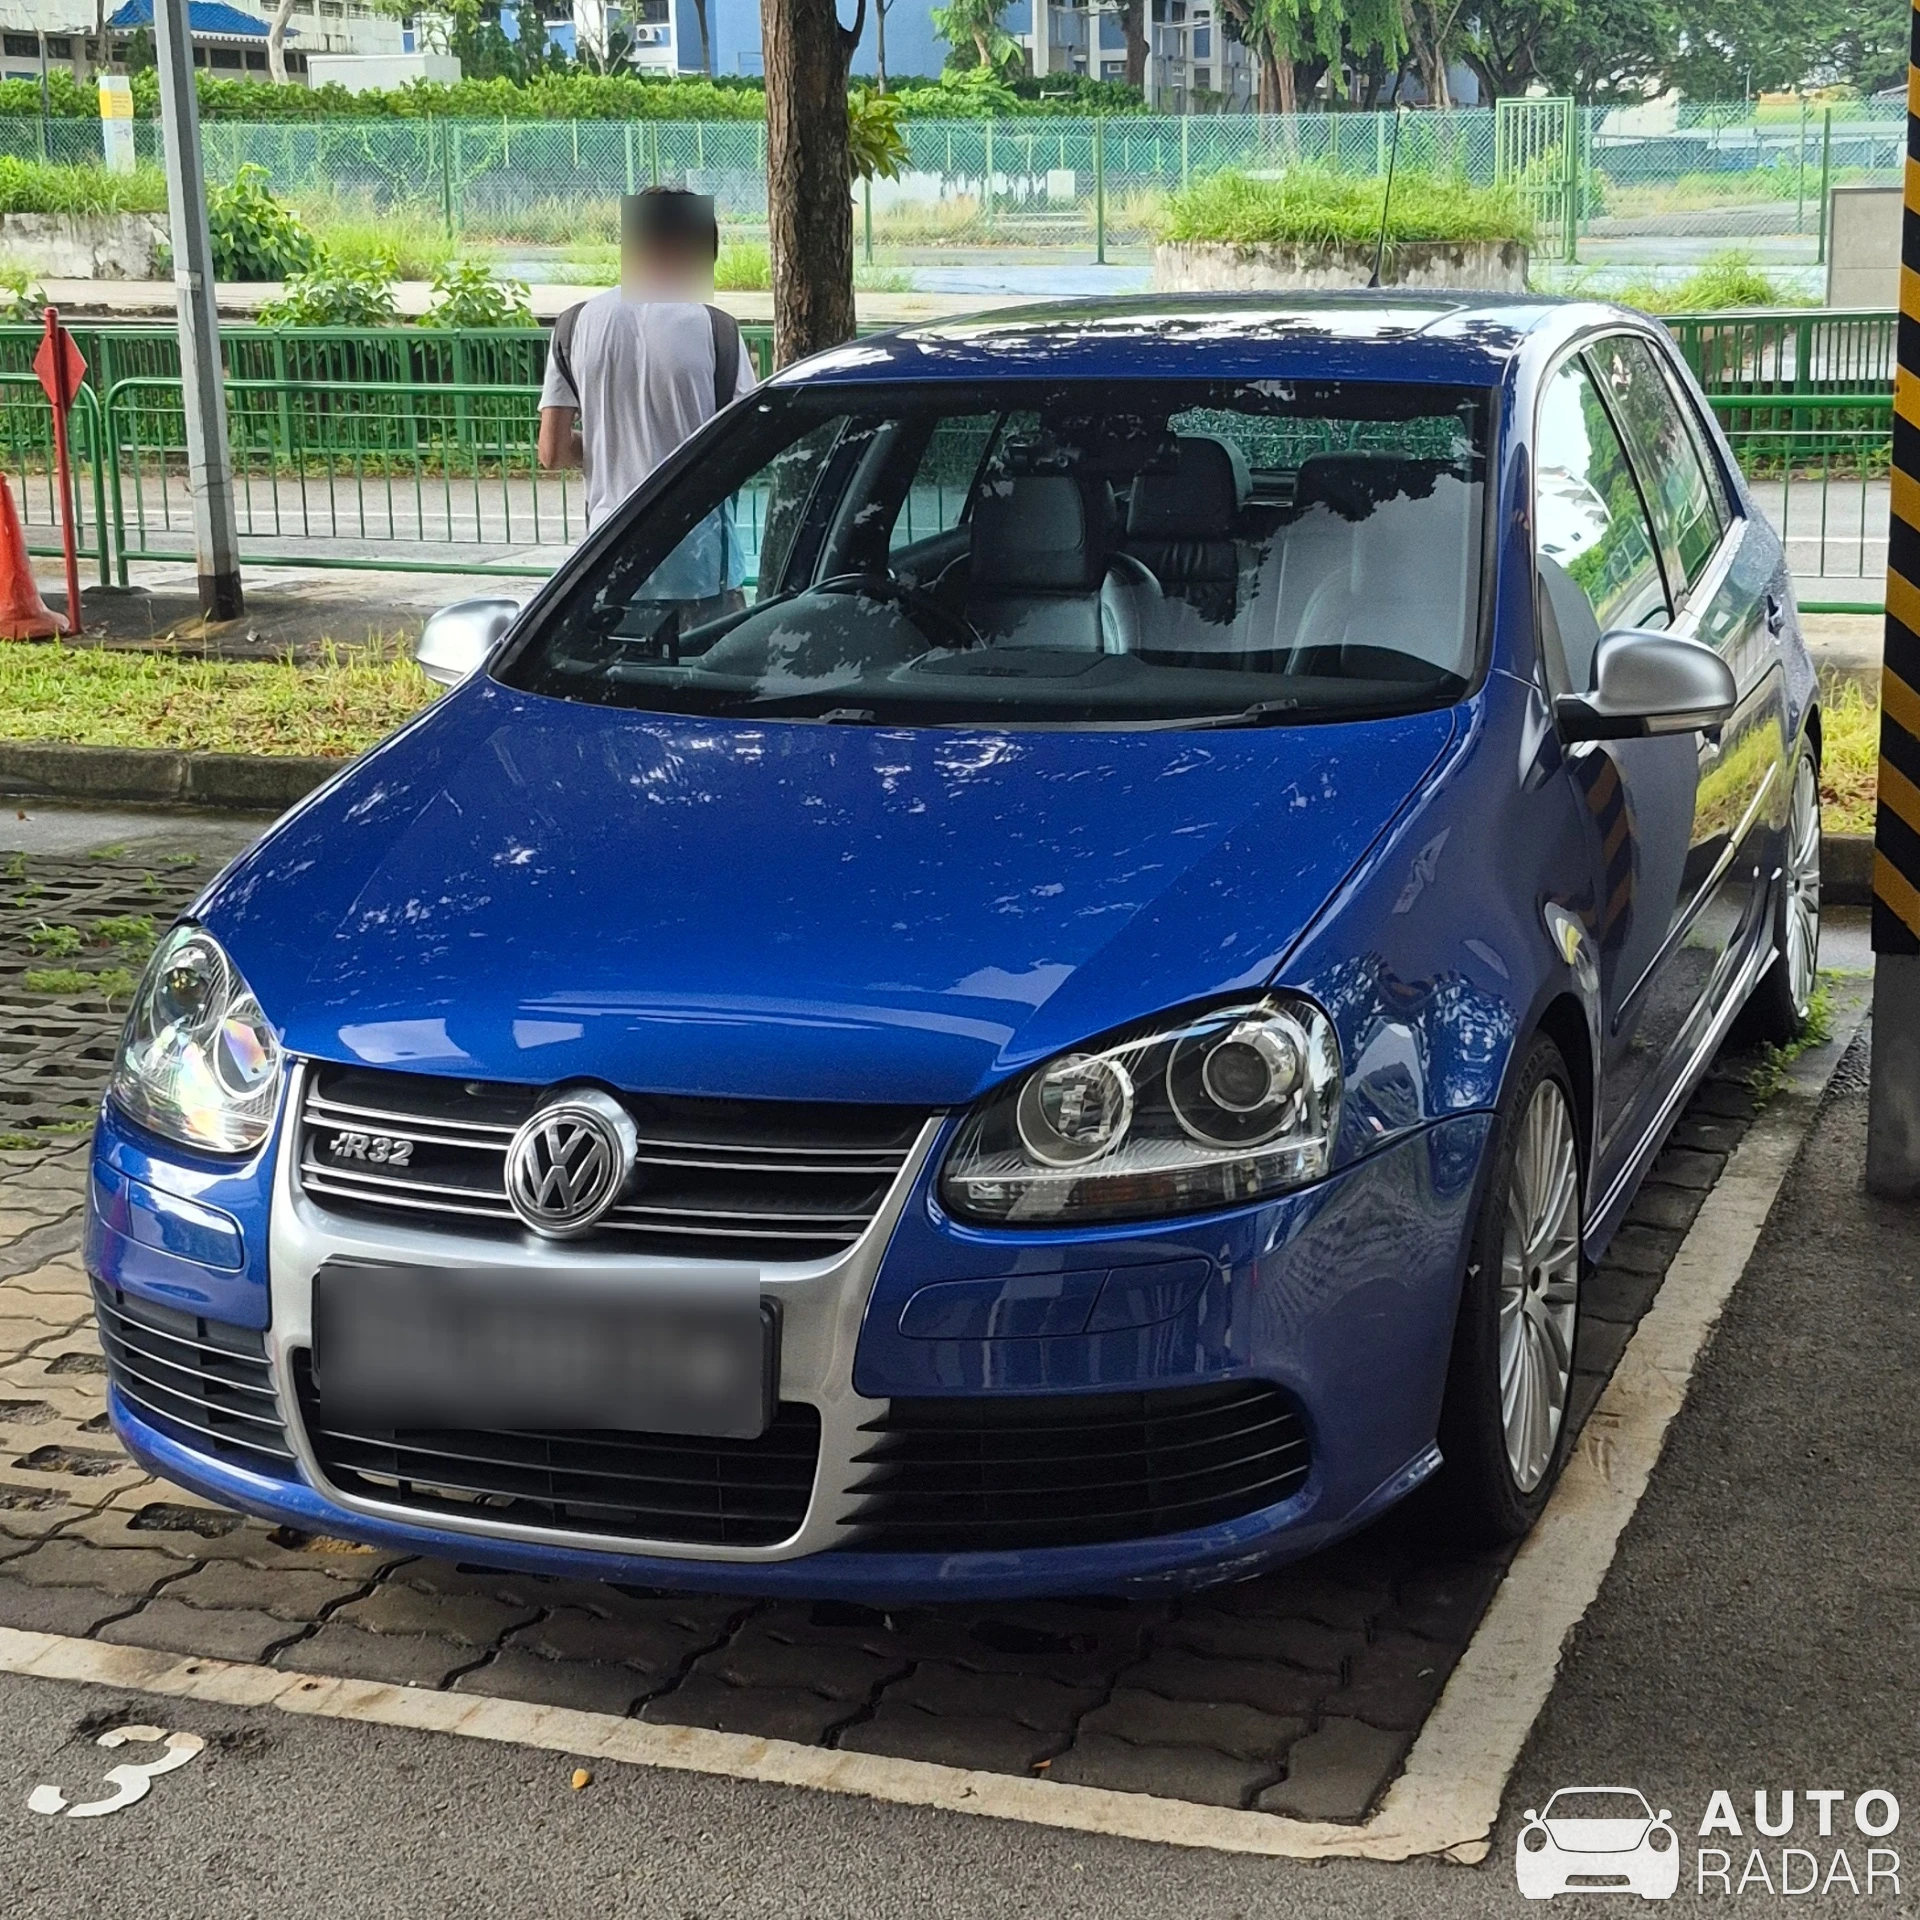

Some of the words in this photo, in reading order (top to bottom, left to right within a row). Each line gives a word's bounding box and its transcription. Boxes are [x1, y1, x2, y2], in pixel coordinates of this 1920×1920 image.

[342, 1132, 414, 1167] R32
[521, 1116, 607, 1216] VW
[27, 1724, 205, 1818] 3
